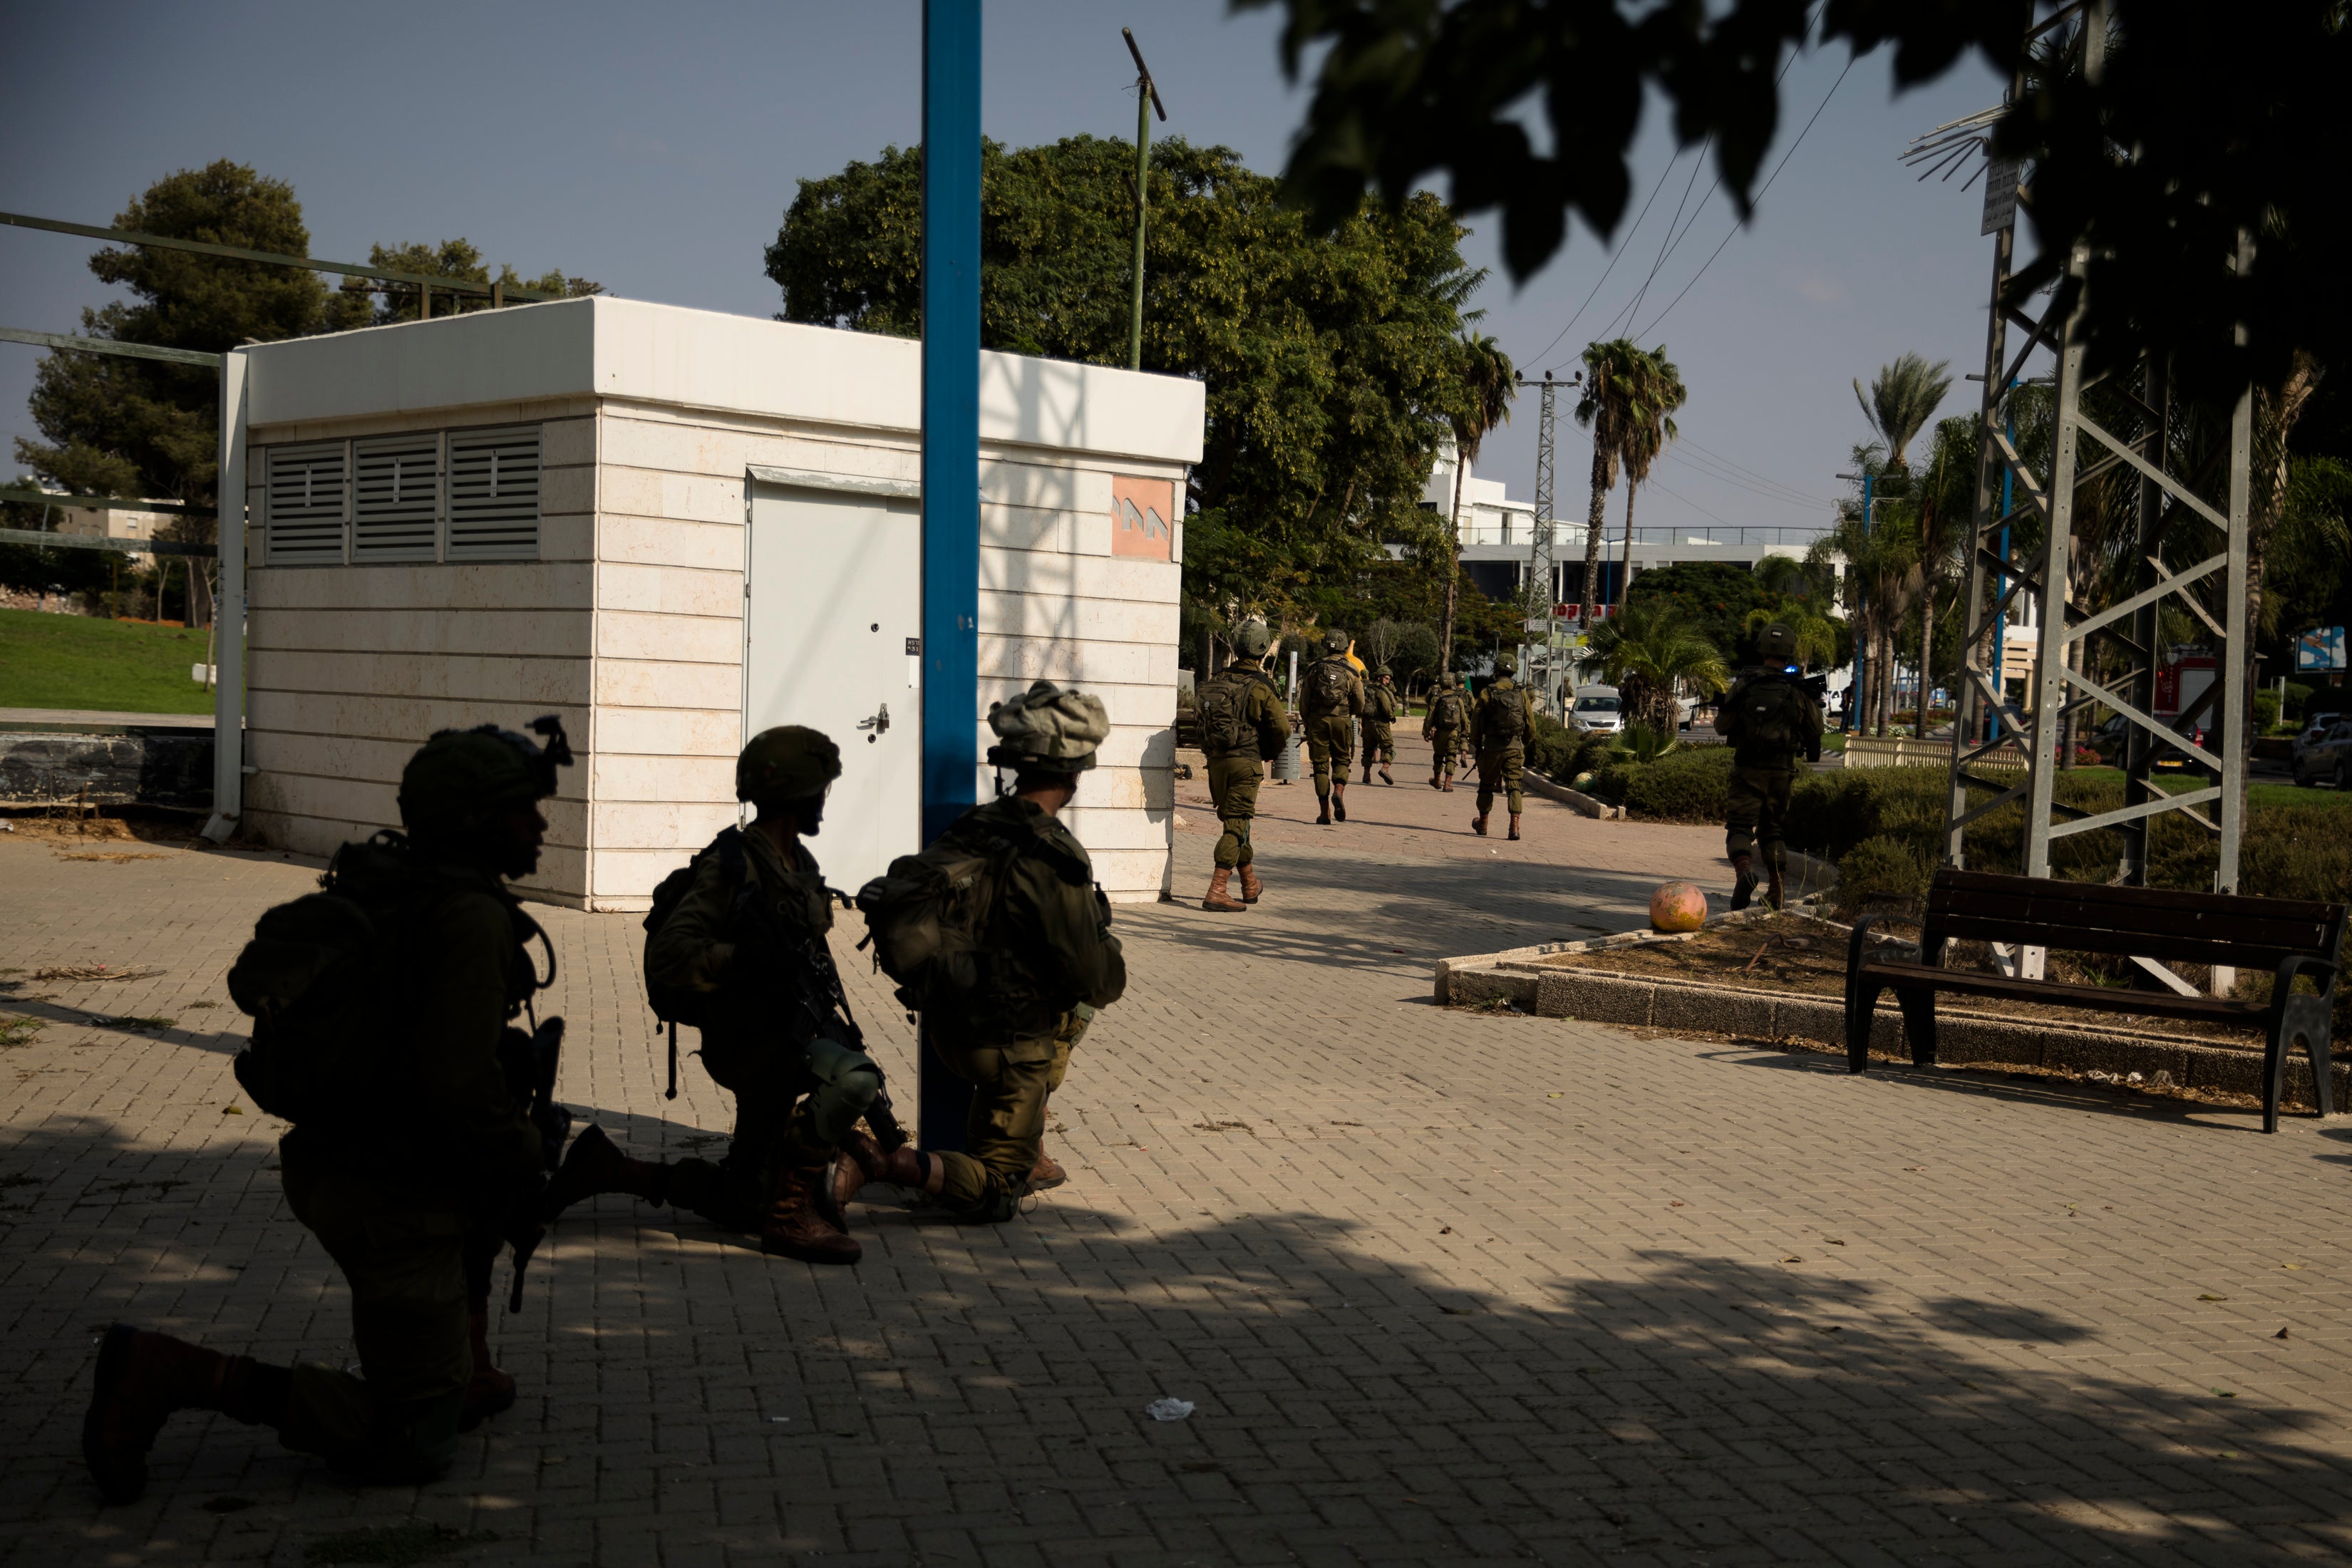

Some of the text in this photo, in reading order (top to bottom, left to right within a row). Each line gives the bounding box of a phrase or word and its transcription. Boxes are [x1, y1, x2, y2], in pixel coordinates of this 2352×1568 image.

[2001, 172, 2016, 188] סכנת
[1985, 197, 1998, 211] Danger
[1998, 192, 2003, 205] of
